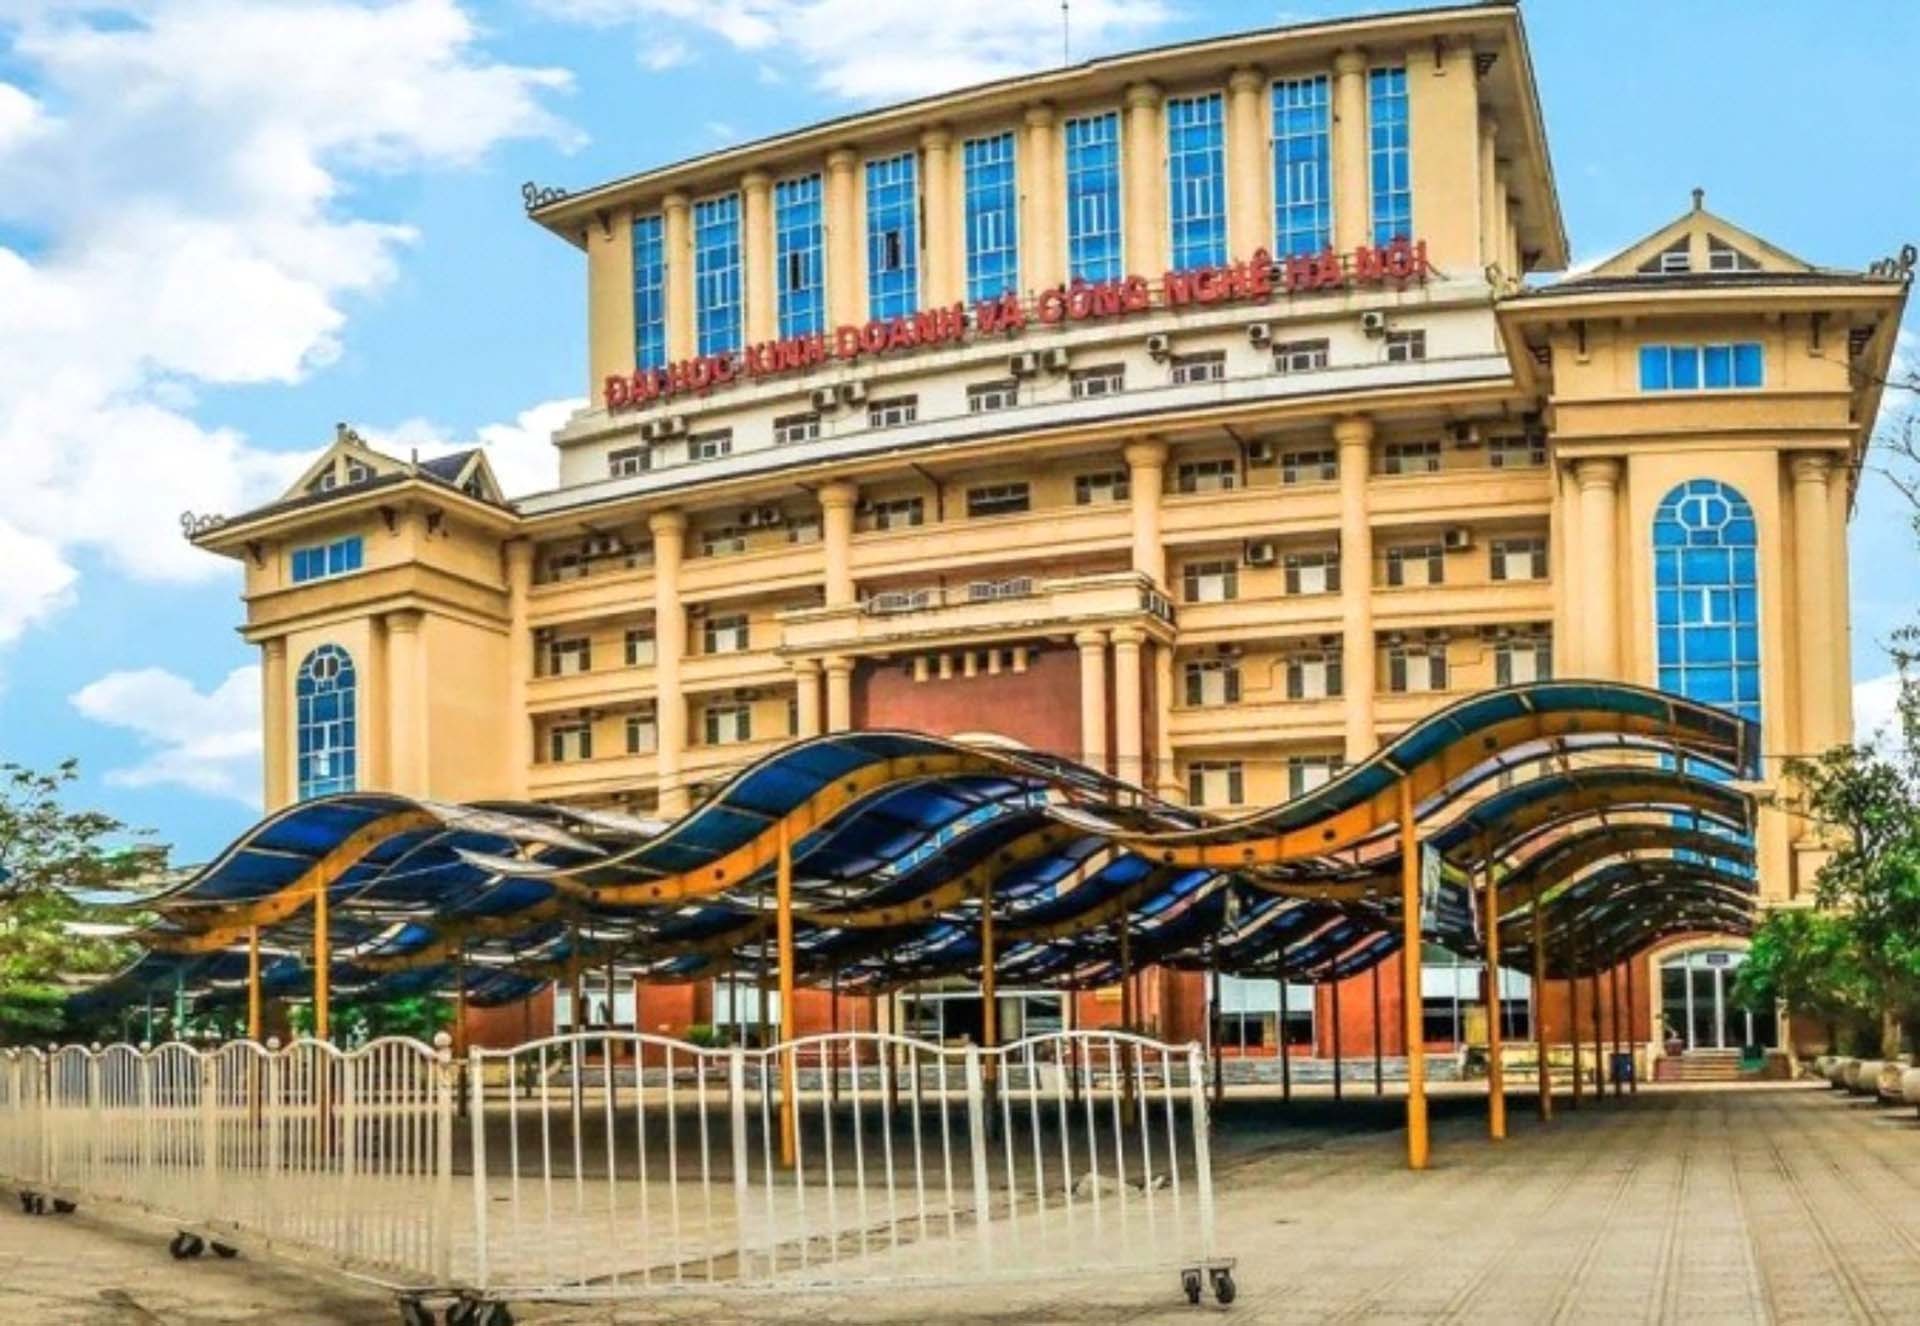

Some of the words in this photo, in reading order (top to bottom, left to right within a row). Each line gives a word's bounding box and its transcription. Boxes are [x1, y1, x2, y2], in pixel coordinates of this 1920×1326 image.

[746, 333, 826, 376] KINH
[836, 301, 965, 360] DOANH
[1039, 274, 1149, 324] CÔNG
